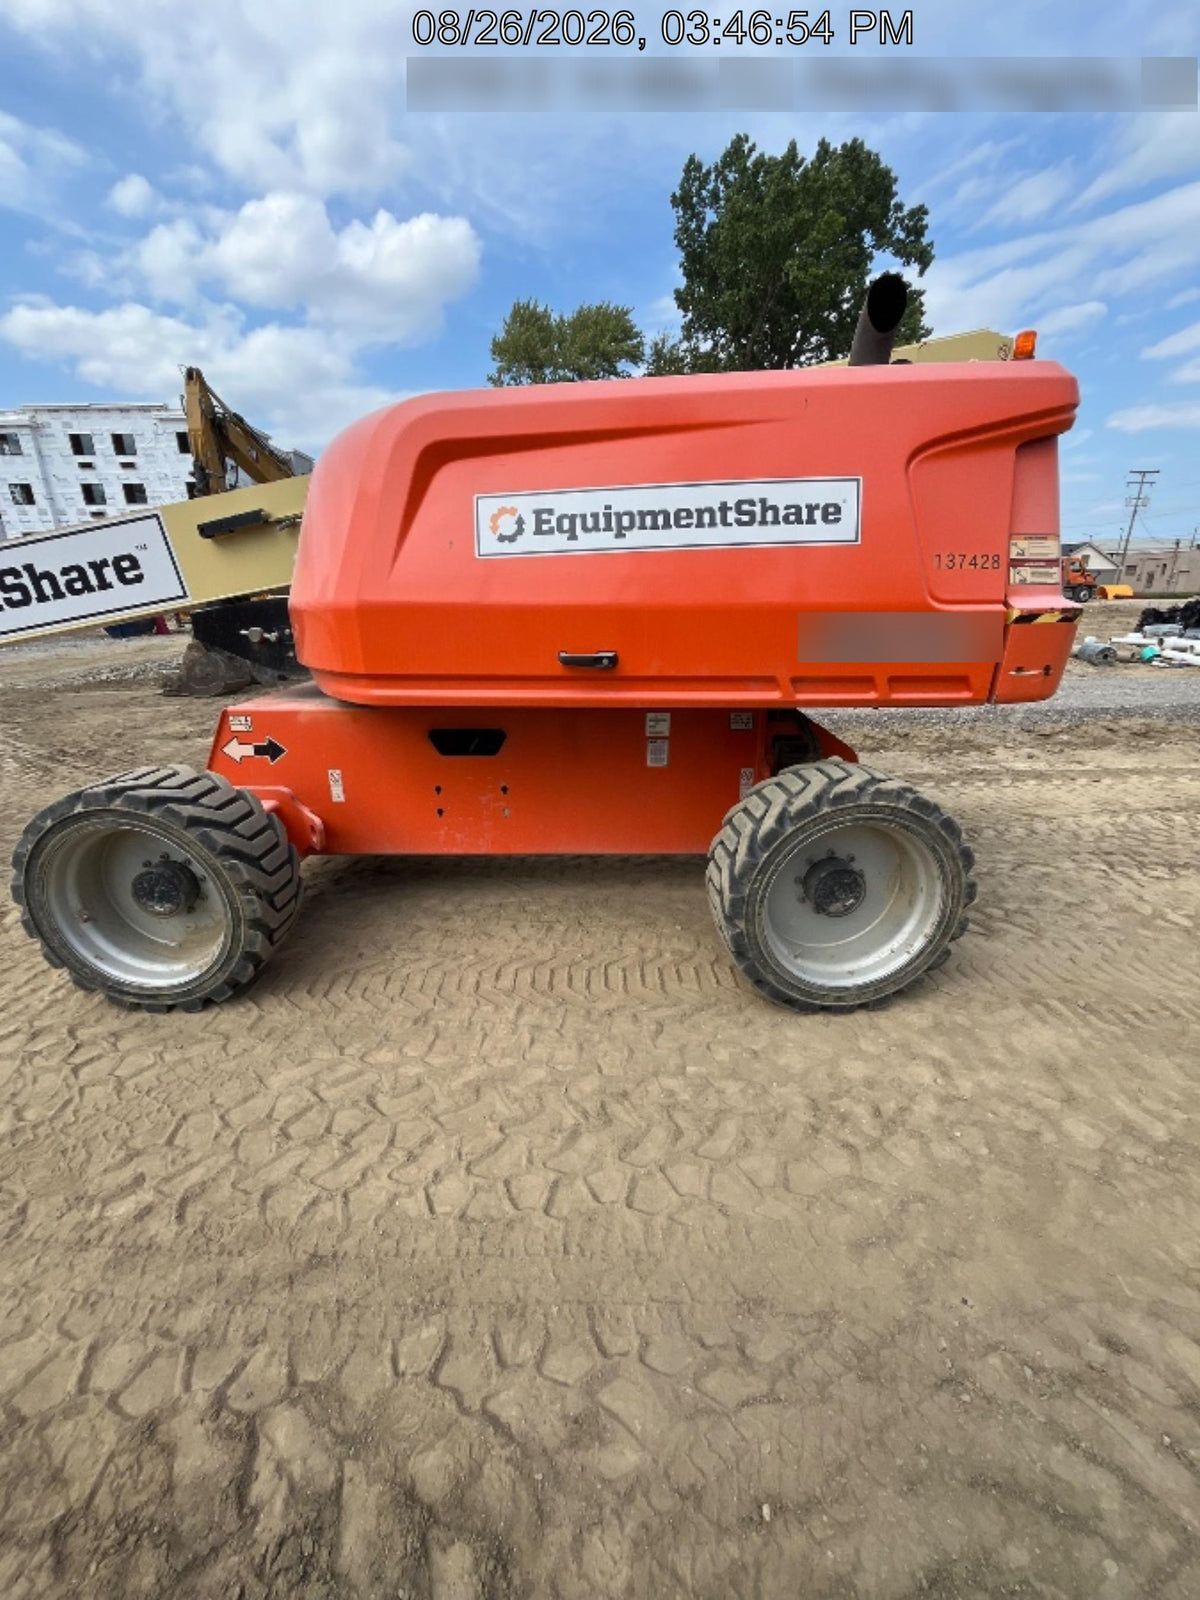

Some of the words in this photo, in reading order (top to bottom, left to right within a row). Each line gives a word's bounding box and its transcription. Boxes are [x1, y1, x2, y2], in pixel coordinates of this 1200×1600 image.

[532, 498, 842, 540] EquipmentShare
[0, 553, 144, 612] Share
[935, 553, 1001, 570] 137428
